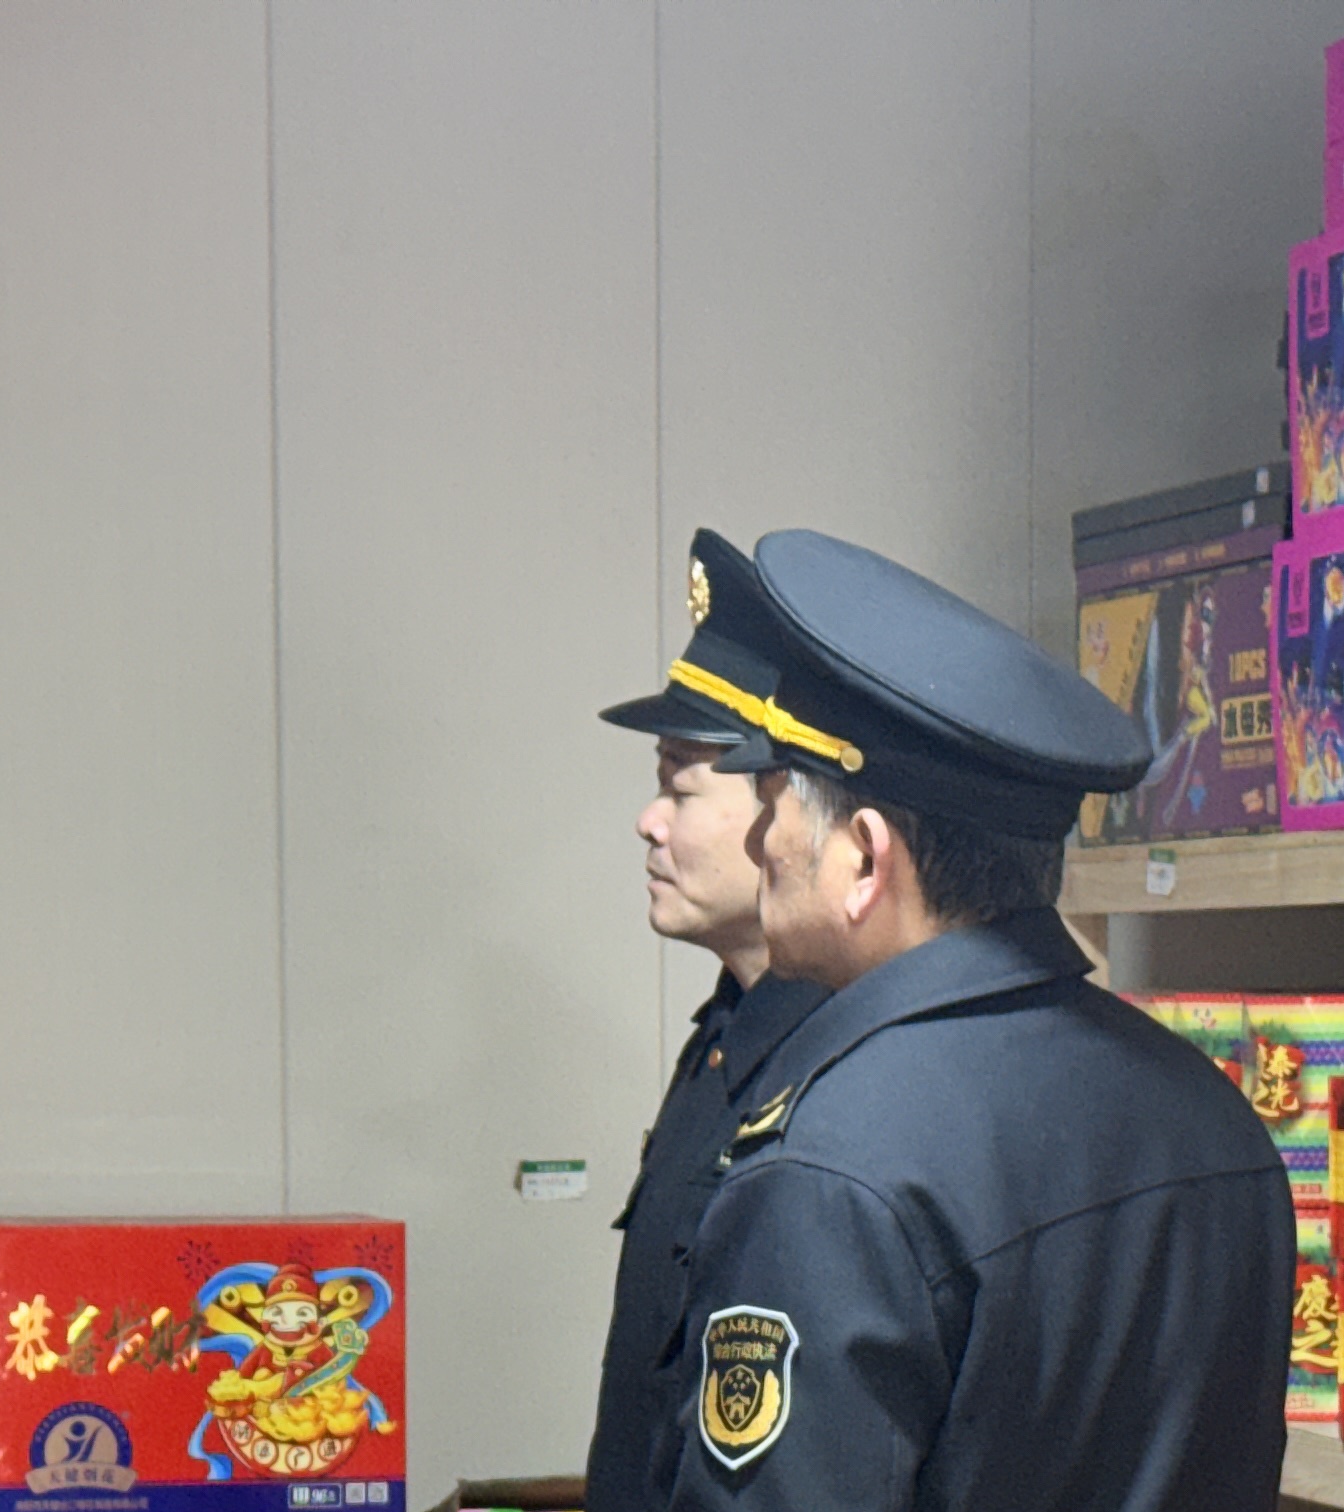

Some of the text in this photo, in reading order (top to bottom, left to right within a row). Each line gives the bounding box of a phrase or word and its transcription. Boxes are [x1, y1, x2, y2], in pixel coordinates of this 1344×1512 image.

[1293, 1274, 1339, 1319] 慶
[6, 1293, 209, 1381] 恭喜发财
